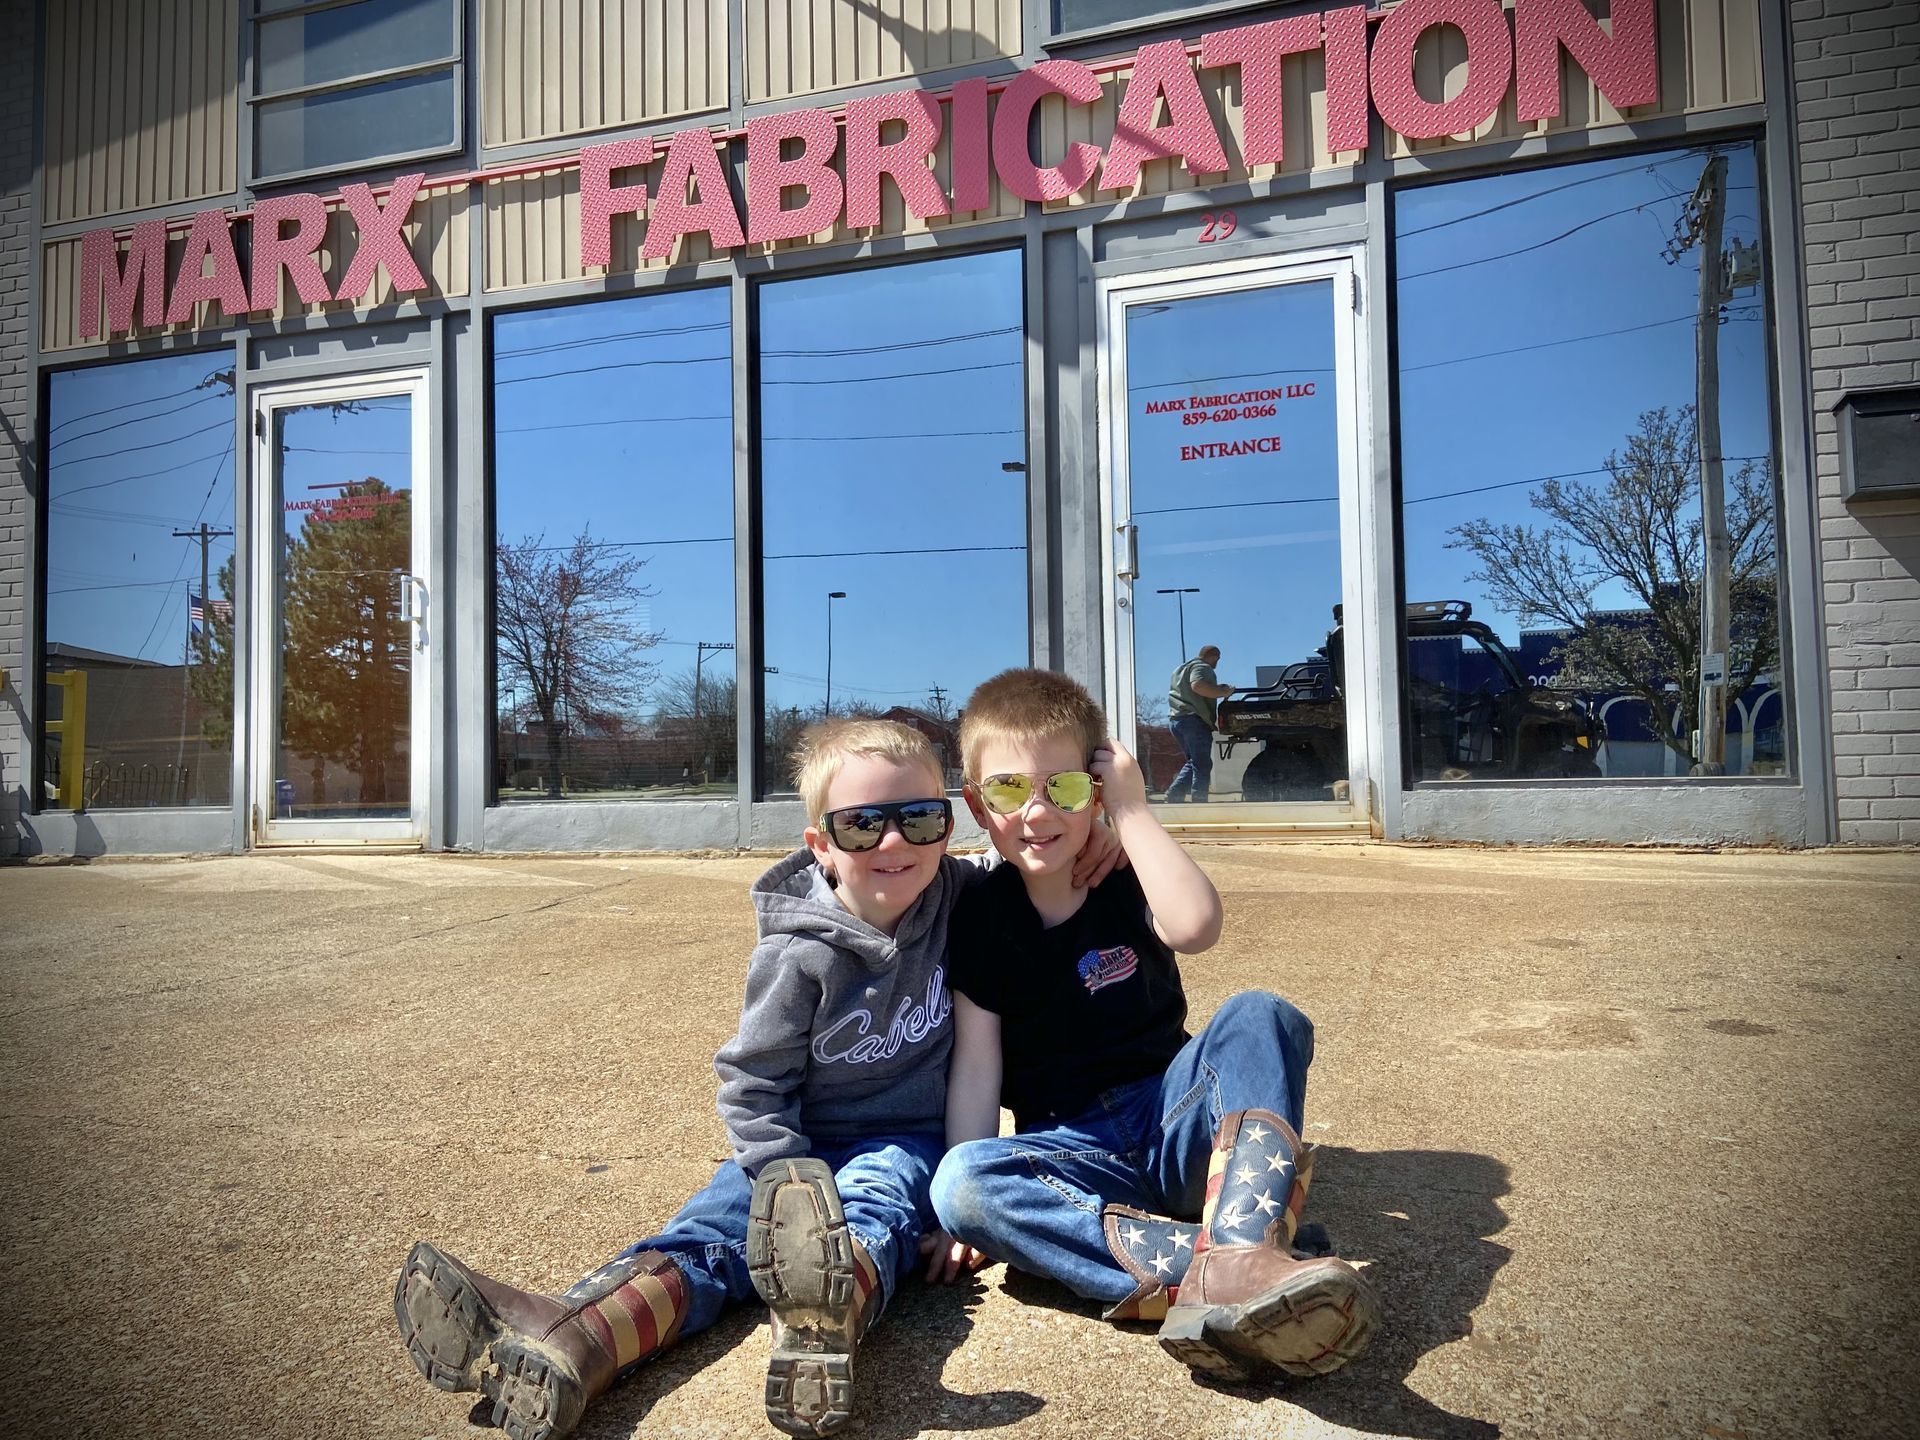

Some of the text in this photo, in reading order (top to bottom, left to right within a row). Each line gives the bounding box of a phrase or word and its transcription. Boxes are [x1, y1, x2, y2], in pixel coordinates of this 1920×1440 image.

[79, 0, 1656, 337] MARX FABRICATION
[1198, 211, 1237, 243] 29
[1145, 383, 1315, 414] MARX FABRICATION LLC
[1183, 404, 1277, 426] 859-620-0366
[1180, 437, 1281, 460] ENTRANCE
